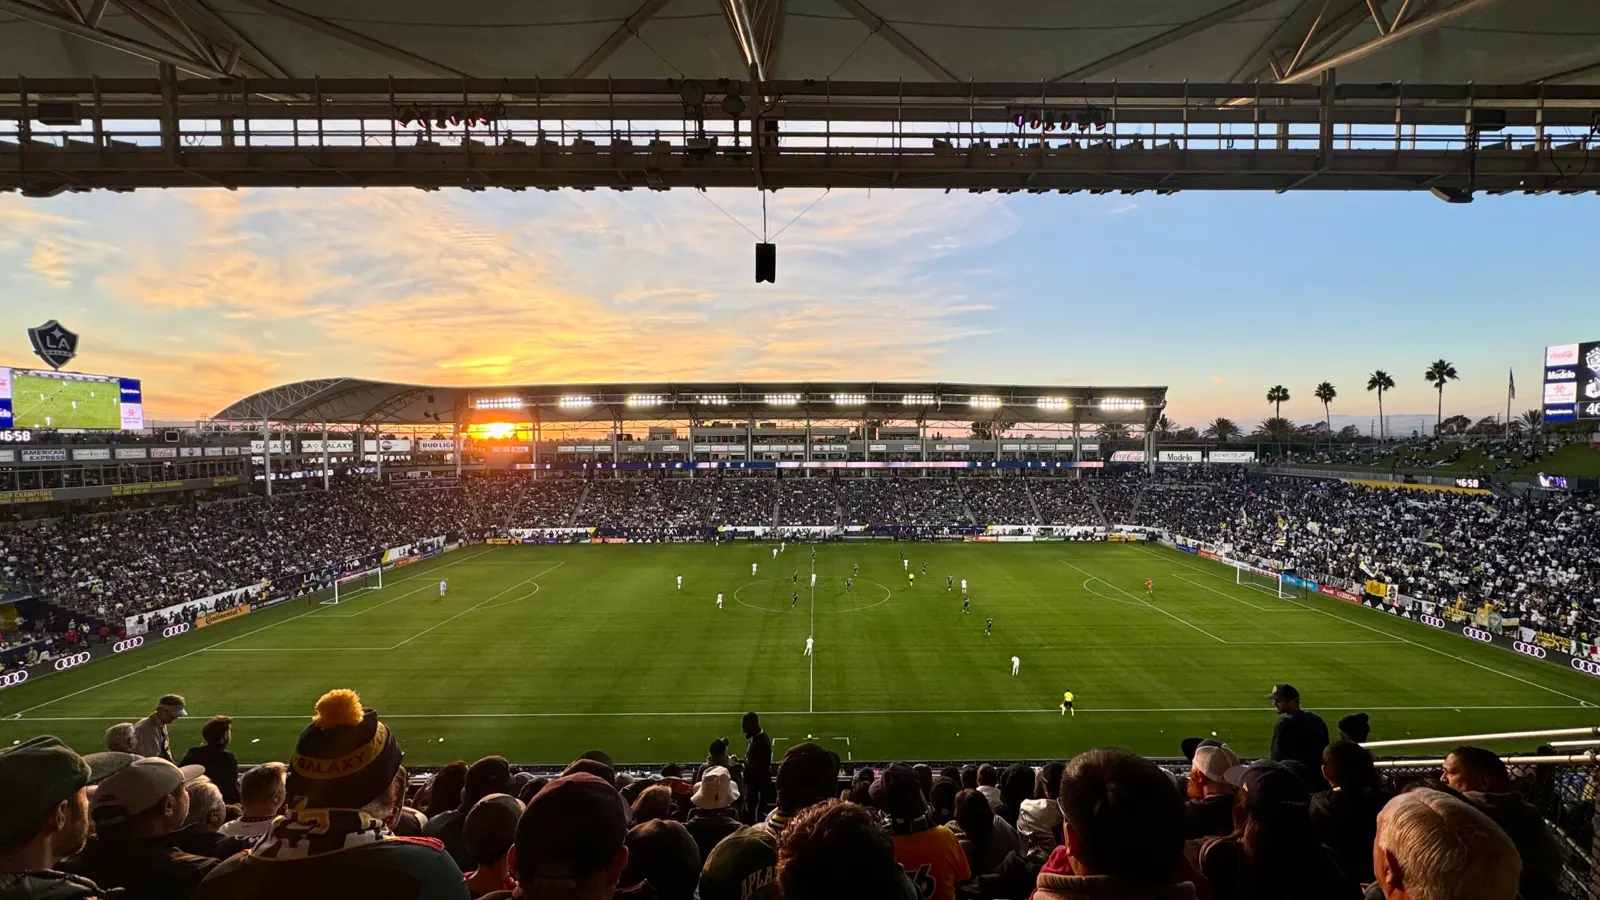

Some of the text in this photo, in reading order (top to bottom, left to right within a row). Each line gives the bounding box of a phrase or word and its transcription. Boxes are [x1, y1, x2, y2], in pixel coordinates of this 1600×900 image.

[46, 336, 71, 350] LA
[1547, 370, 1576, 380] Modelo
[1113, 451, 1143, 461] Coca-Cola
[1167, 453, 1193, 461] Modelo
[1456, 479, 1478, 488] 46:58
[205, 608, 238, 625] Continental
[298, 751, 365, 773] GALAXY
